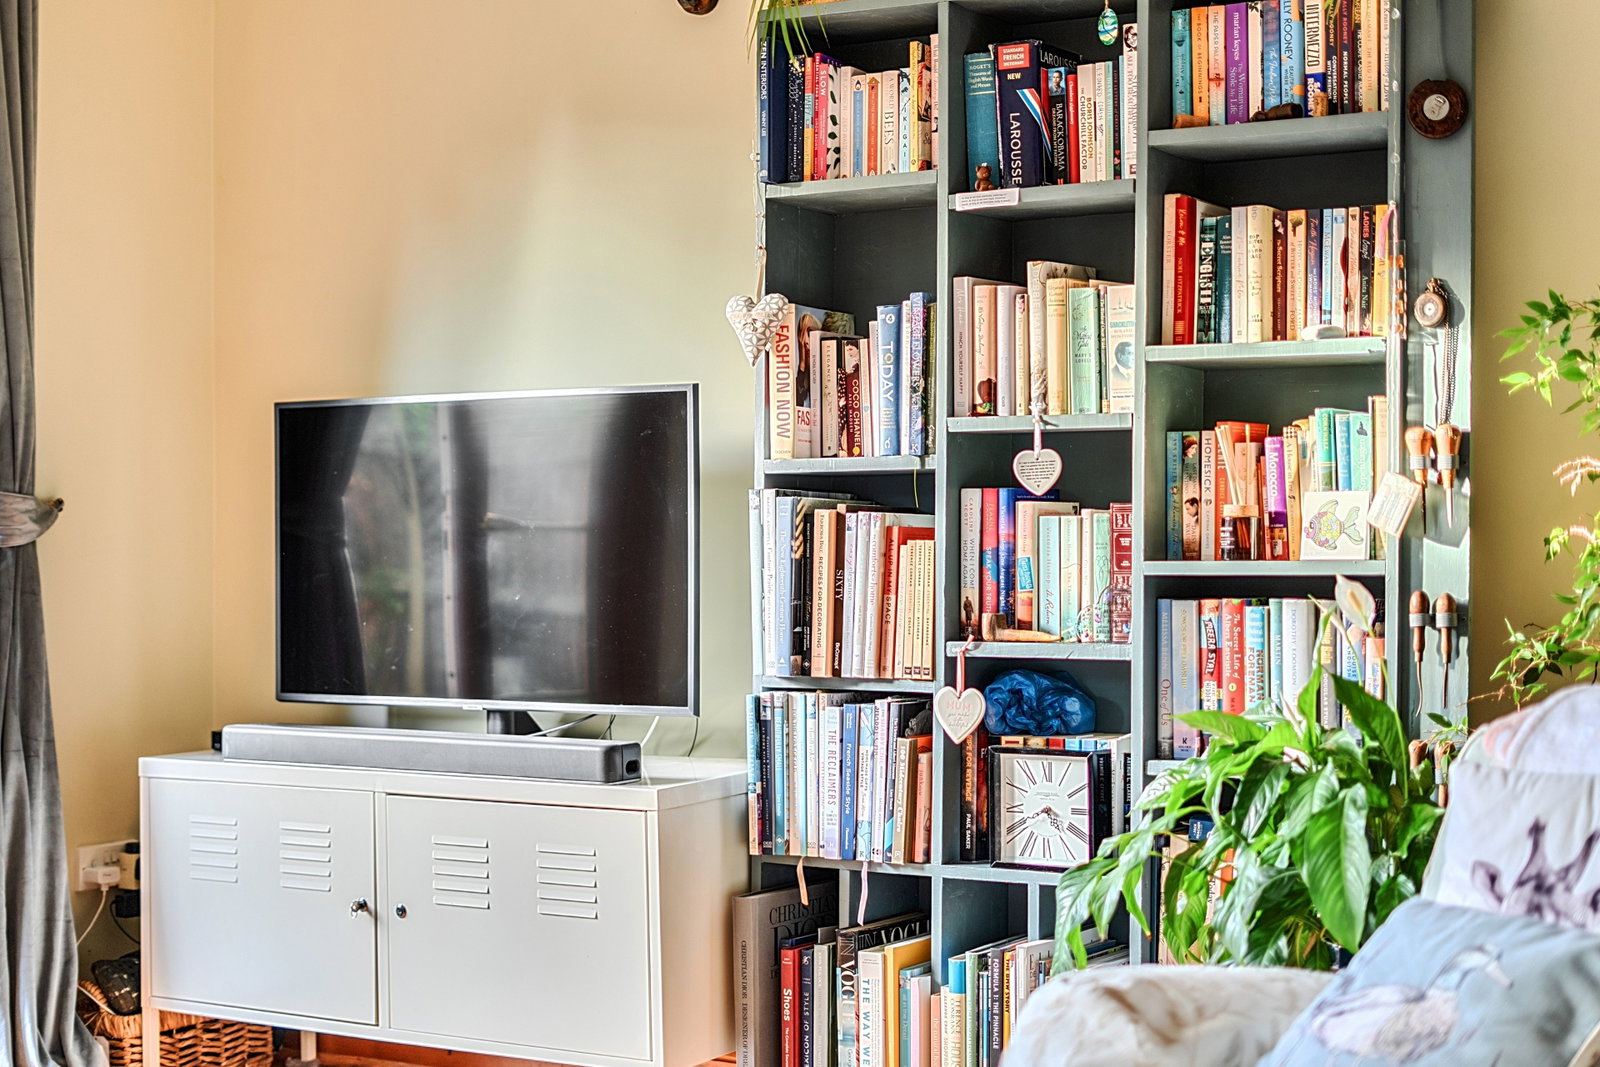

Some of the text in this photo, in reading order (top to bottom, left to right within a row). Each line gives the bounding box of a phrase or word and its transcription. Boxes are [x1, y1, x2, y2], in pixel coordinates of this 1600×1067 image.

[1233, 39, 1241, 61] keyes
[1306, 4, 1320, 67] INTERMEZZO
[1307, 78, 1315, 117] ROONEY
[884, 111, 894, 145] BEES
[1010, 112, 1021, 185] LAROUSSE
[1362, 211, 1370, 238] LADIES
[1199, 242, 1214, 304] ENGLISH
[911, 295, 921, 387] VINTAGE FLOWERS
[776, 325, 790, 439] FASHION NOW
[881, 341, 894, 401] TODAY
[852, 379, 861, 447] COCO CHANEL
[1204, 438, 1212, 493] HOMESICK
[1269, 451, 1279, 497] Morocco
[887, 568, 893, 579] IN
[888, 556, 893, 567] UP
[835, 570, 843, 600] SIXTY
[870, 582, 878, 605] home
[887, 580, 893, 593] MY
[1204, 620, 1216, 675] MEERA SYAL
[1233, 627, 1241, 651] Secret
[1233, 654, 1241, 670] Life
[1233, 672, 1240, 680] of
[1256, 649, 1264, 701] NORMAN
[1160, 679, 1171, 726] One of Us
[827, 729, 837, 806] THE RECLAIMERS
[897, 761, 905, 805] Midcentury
[839, 936, 855, 1023] IN VOGUE
[862, 979, 870, 1003] THE
[783, 988, 792, 1021] Shoes
[862, 1011, 870, 1039] WAY
[743, 1041, 748, 1049] OF
